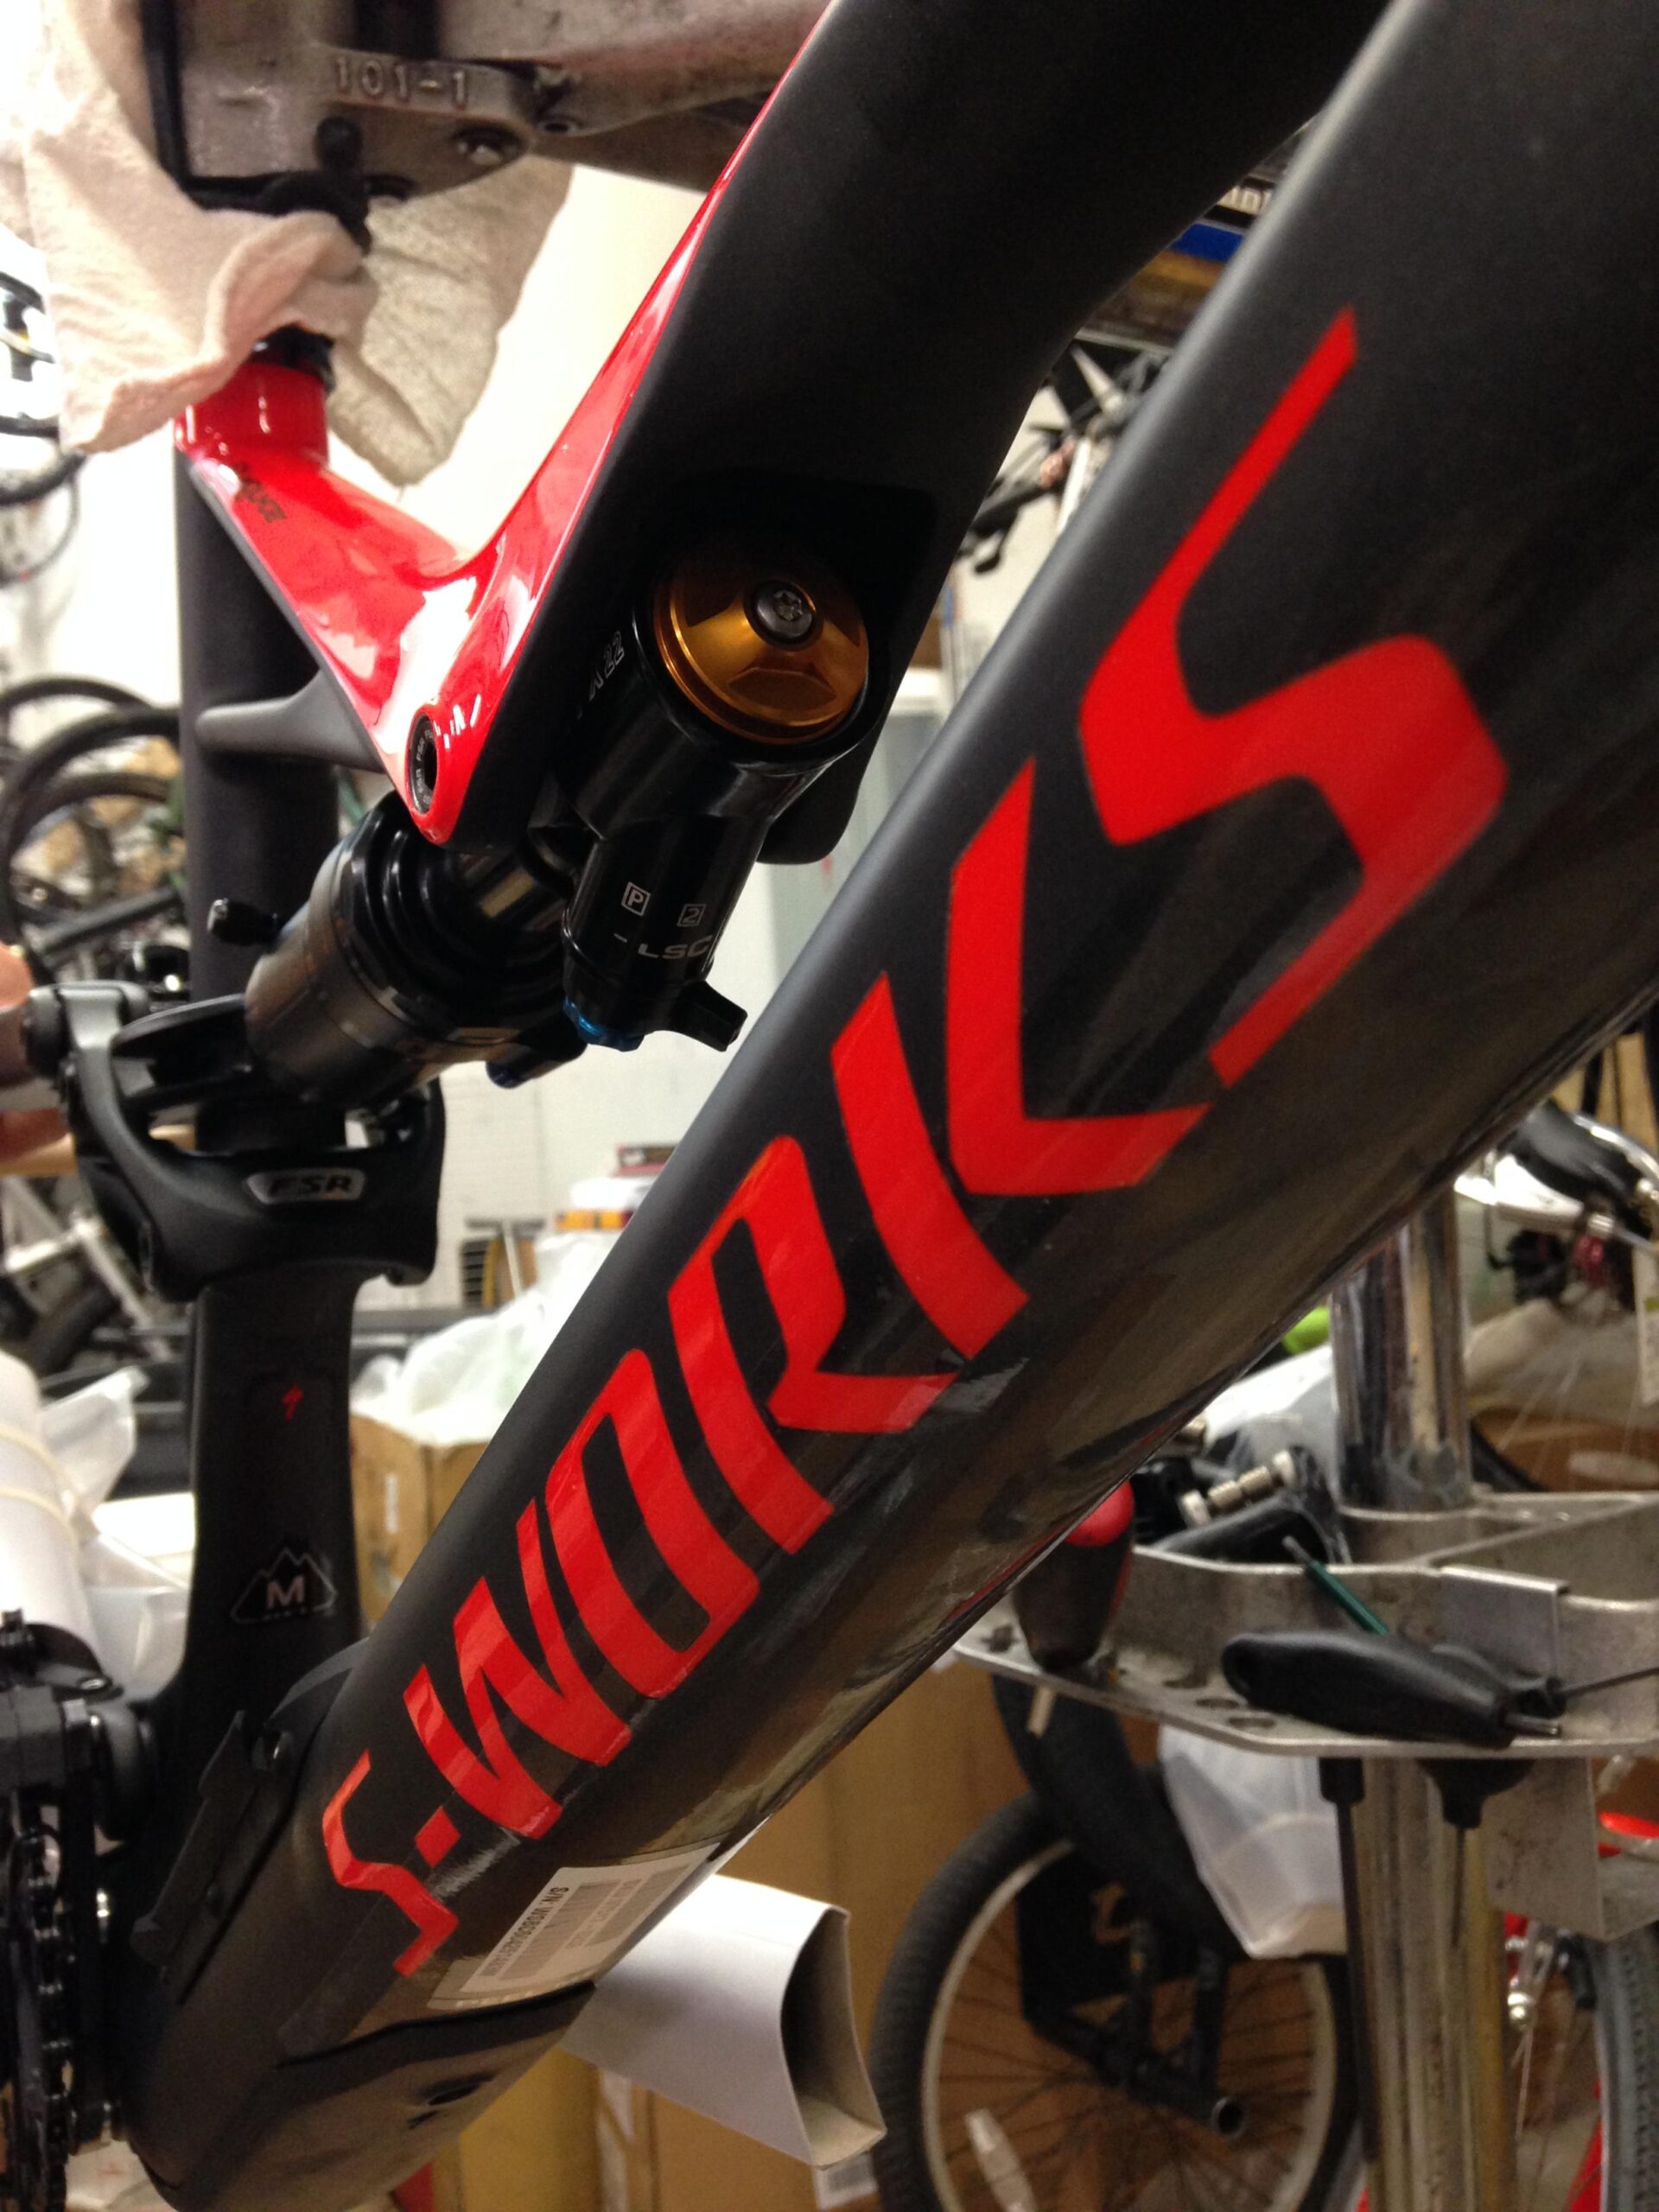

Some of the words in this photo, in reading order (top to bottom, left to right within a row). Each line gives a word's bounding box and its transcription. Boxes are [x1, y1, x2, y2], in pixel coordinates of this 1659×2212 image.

[334, 56, 469, 111] 101-1
[626, 888, 645, 908] P
[681, 906, 701, 925] 2
[638, 934, 714, 960] LSC
[321, 308, 1508, 1979] S-WORKS
